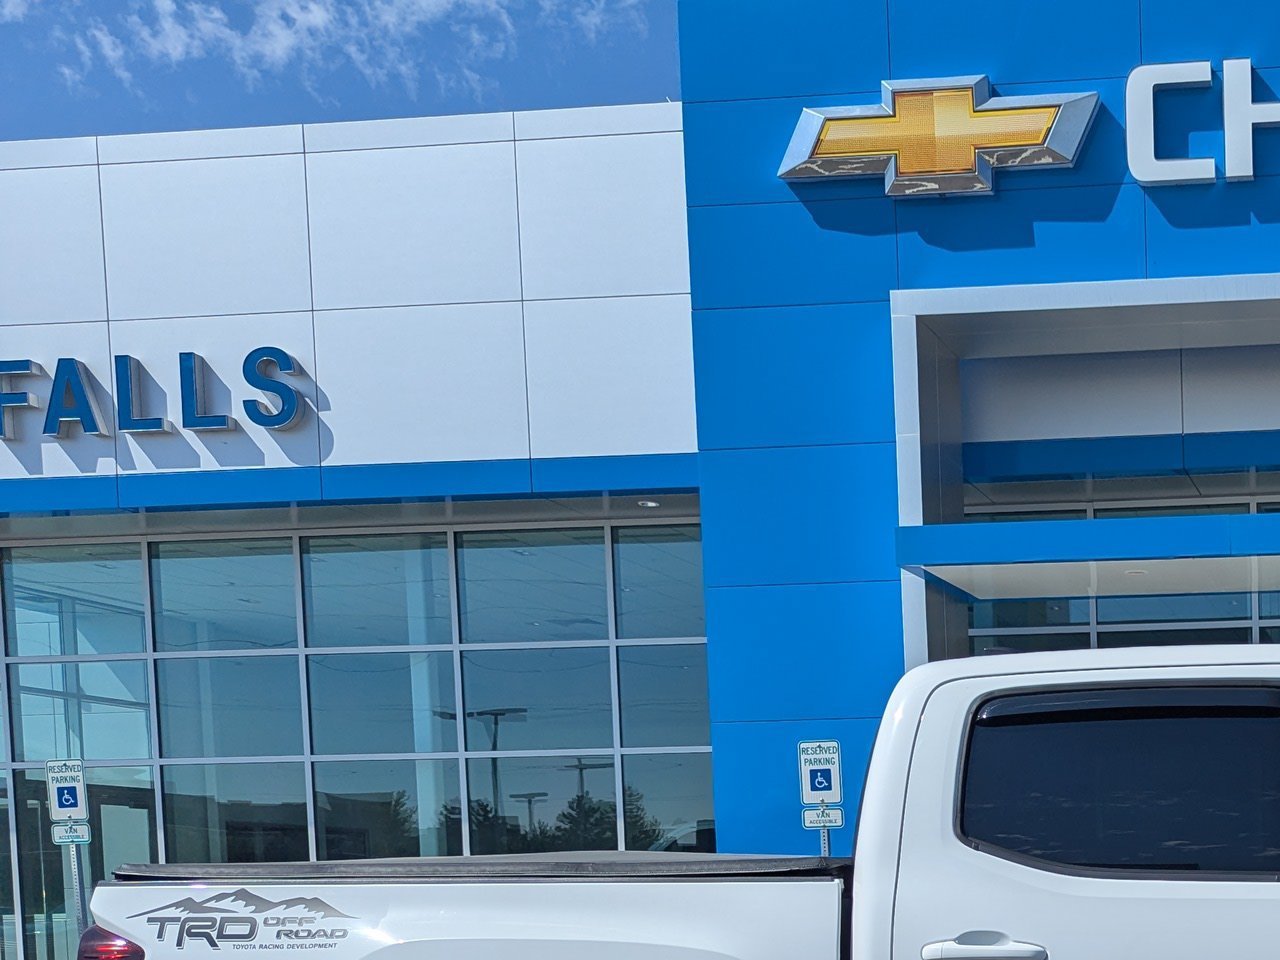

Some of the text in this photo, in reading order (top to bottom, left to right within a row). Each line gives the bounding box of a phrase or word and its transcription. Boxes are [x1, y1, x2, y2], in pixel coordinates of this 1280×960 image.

[0, 345, 304, 438] FALLS
[801, 746, 837, 756] RESERVED
[804, 757, 836, 766] PARKING
[49, 765, 82, 774] RESERVED
[51, 775, 80, 784] PARKING
[146, 916, 318, 950] TRD OFF
[275, 928, 349, 940] ROAD
[286, 942, 338, 950] DEVELOPMENT
